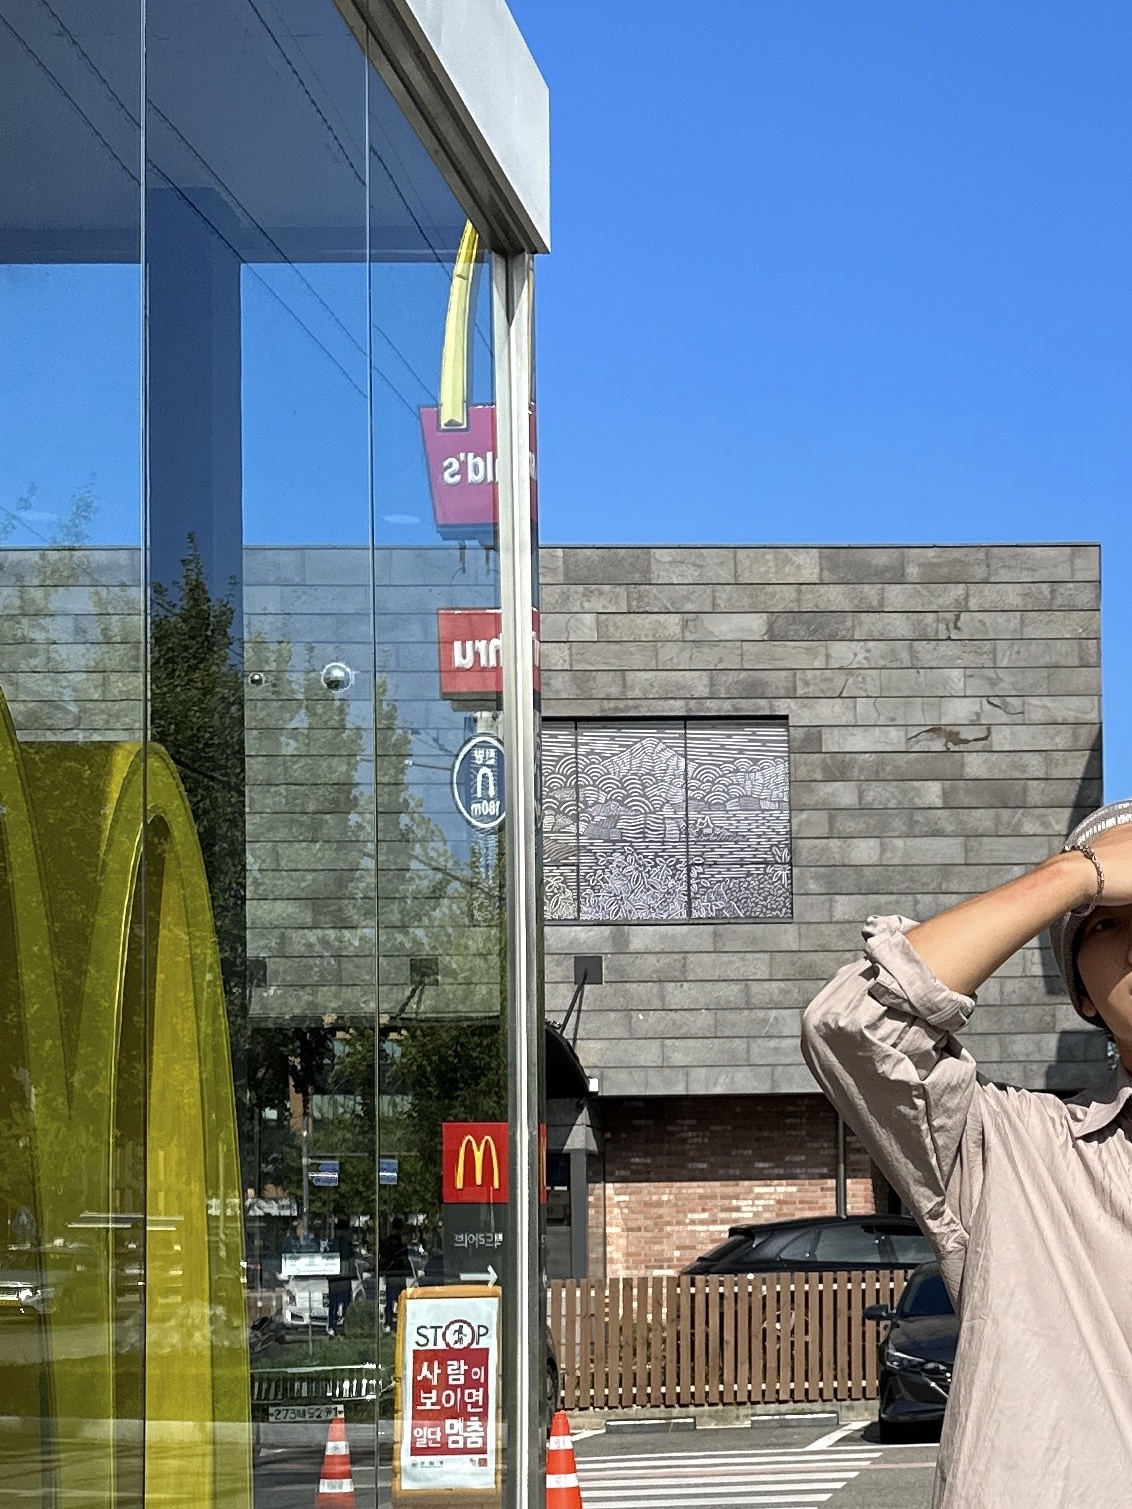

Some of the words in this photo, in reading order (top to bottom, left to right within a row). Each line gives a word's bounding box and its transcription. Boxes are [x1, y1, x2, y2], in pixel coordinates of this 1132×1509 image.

[415, 1319, 489, 1348] STOP
[416, 1360, 485, 1386] 사람이
[416, 1388, 485, 1413] 보이면
[413, 1426, 442, 1448] 일단
